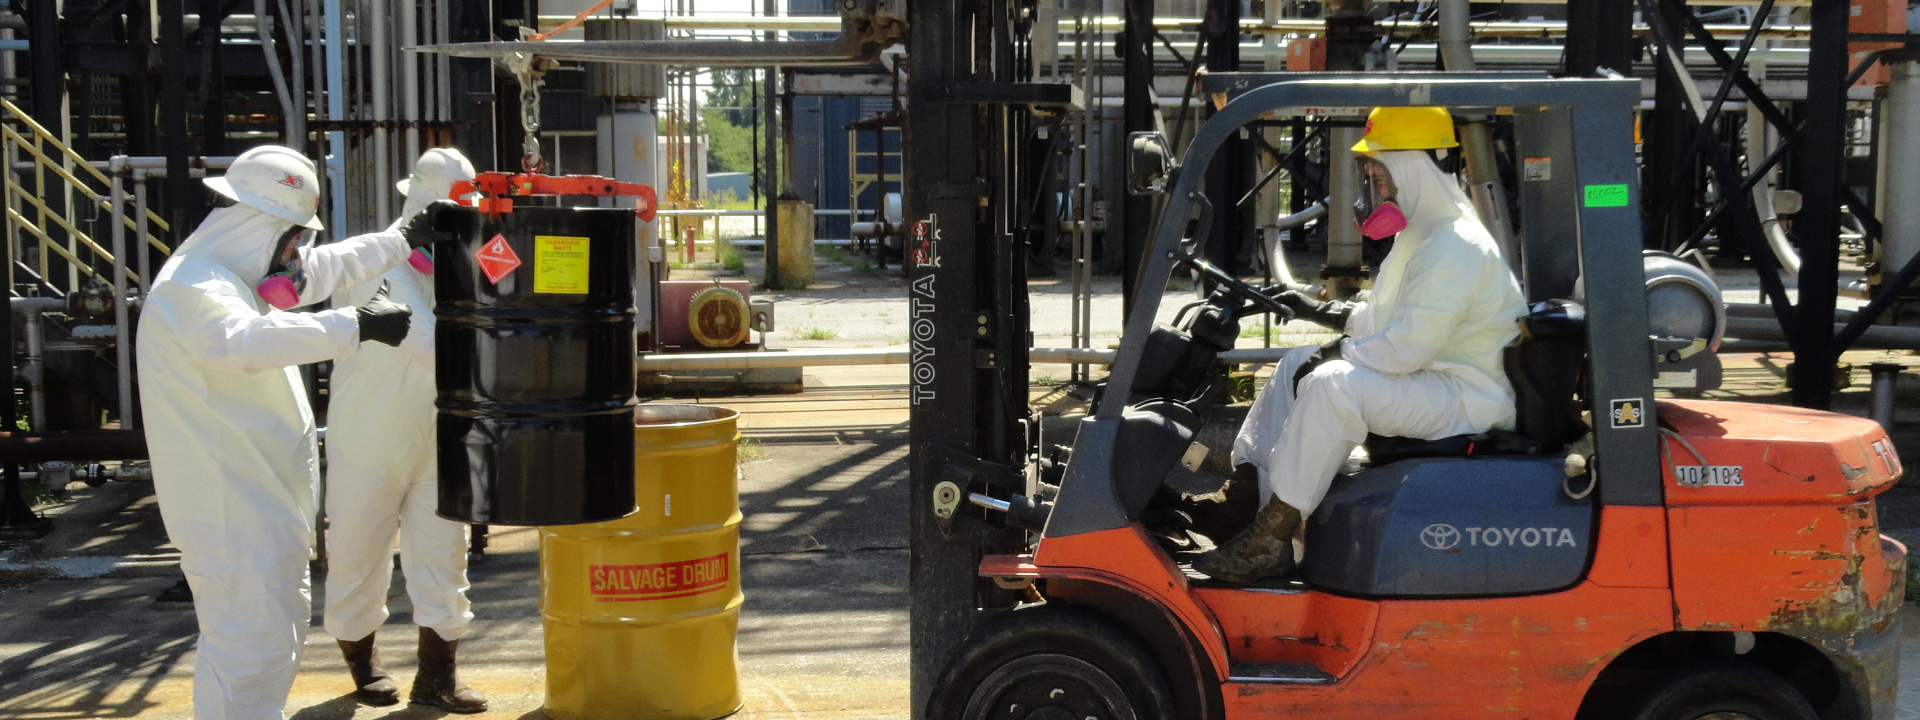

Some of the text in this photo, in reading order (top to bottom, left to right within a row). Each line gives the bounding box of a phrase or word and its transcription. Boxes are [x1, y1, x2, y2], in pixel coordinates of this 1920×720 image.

[913, 274, 935, 405] TOYOTA
[1465, 527, 1576, 547] TOYOTA
[594, 557, 726, 591] SALVAGE DRUM
